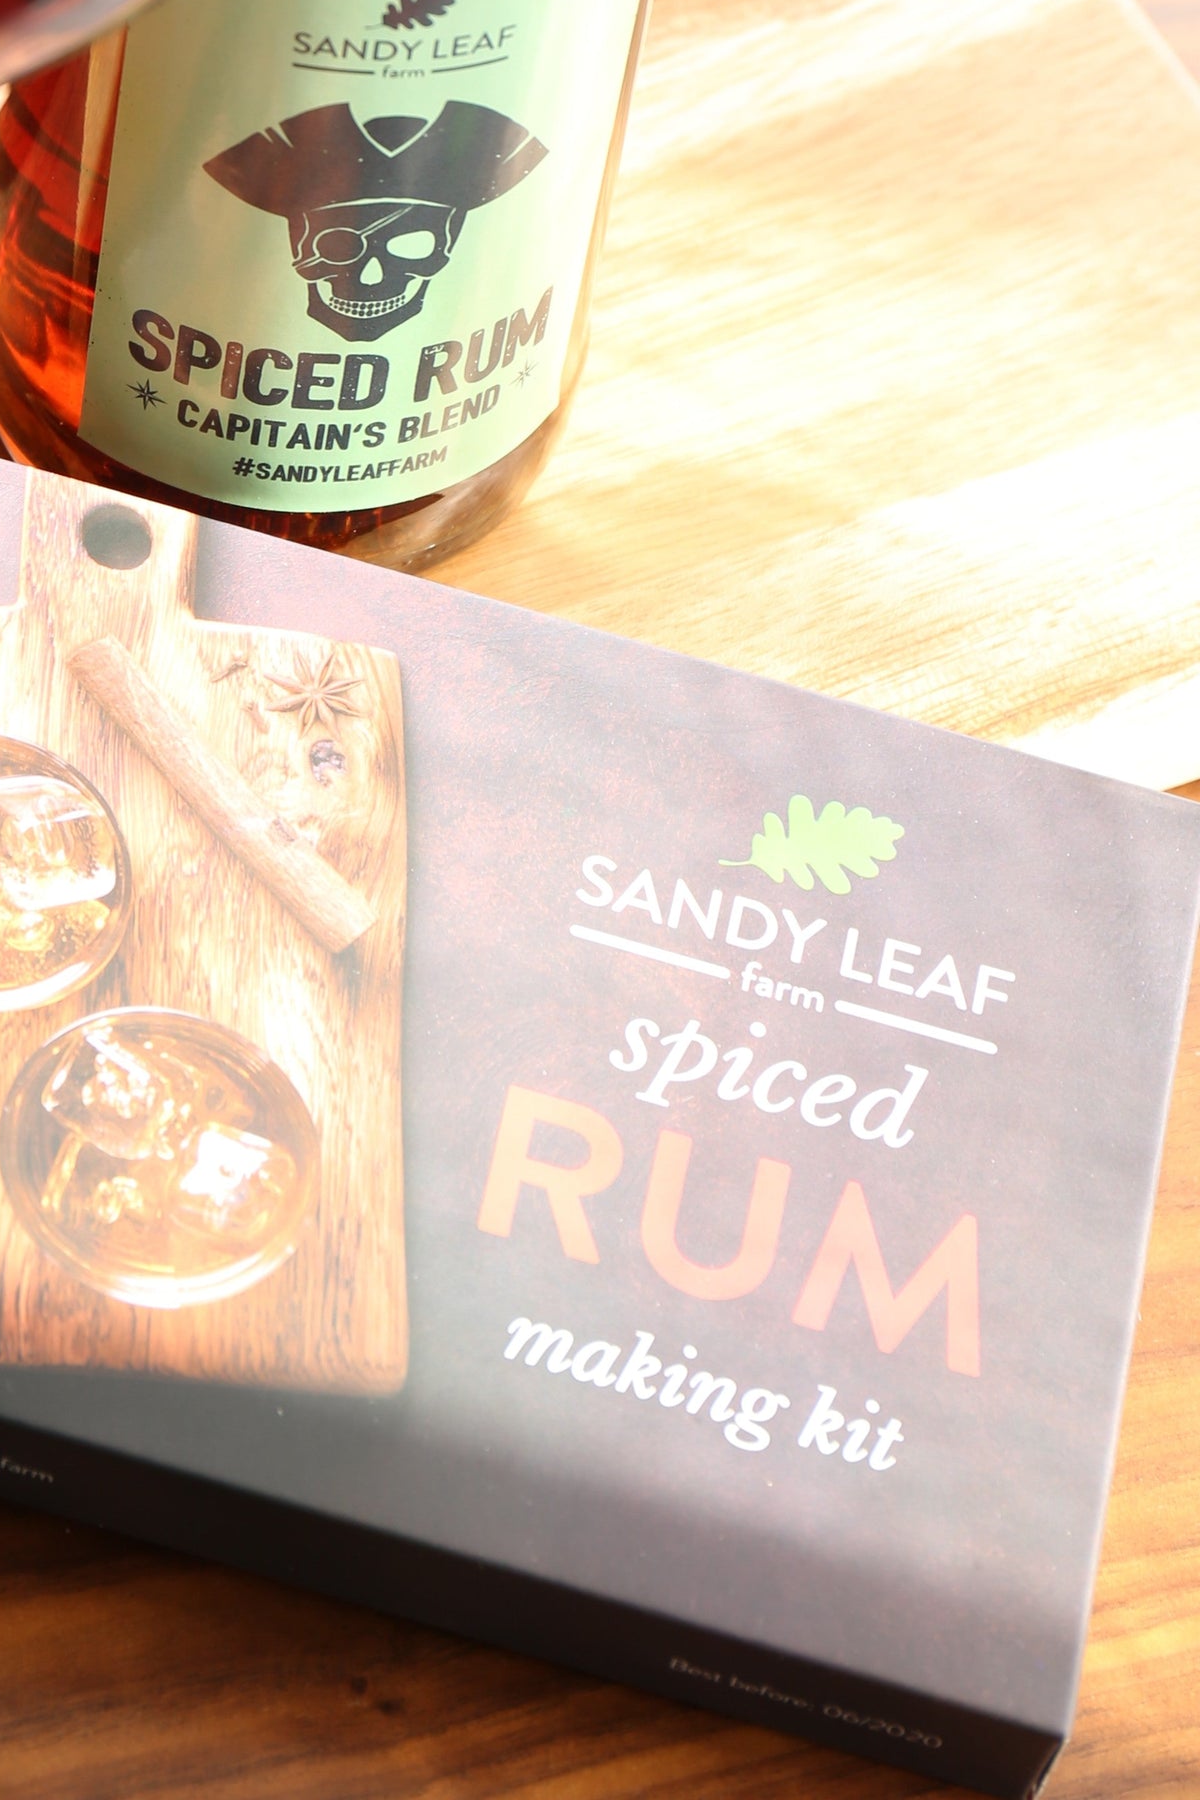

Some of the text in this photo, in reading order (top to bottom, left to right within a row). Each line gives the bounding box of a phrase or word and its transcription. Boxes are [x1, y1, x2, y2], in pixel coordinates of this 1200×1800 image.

[293, 24, 517, 62] SANDY LEAF
[382, 66, 426, 79] farm
[128, 285, 554, 411] SPICED RUM
[177, 384, 501, 451] CAPITAIN'S BLEND
[232, 445, 448, 483] #SANDYLEAFFARM
[576, 855, 1017, 1016] SANDY LEAF
[741, 961, 825, 1012] farm
[609, 1017, 929, 1148] spiced
[476, 1083, 981, 1378] RUM
[503, 1316, 905, 1471] making kit
[0, 1455, 55, 1483] farm
[669, 1656, 721, 1683] Best
[822, 1704, 943, 1749] 06/2020
